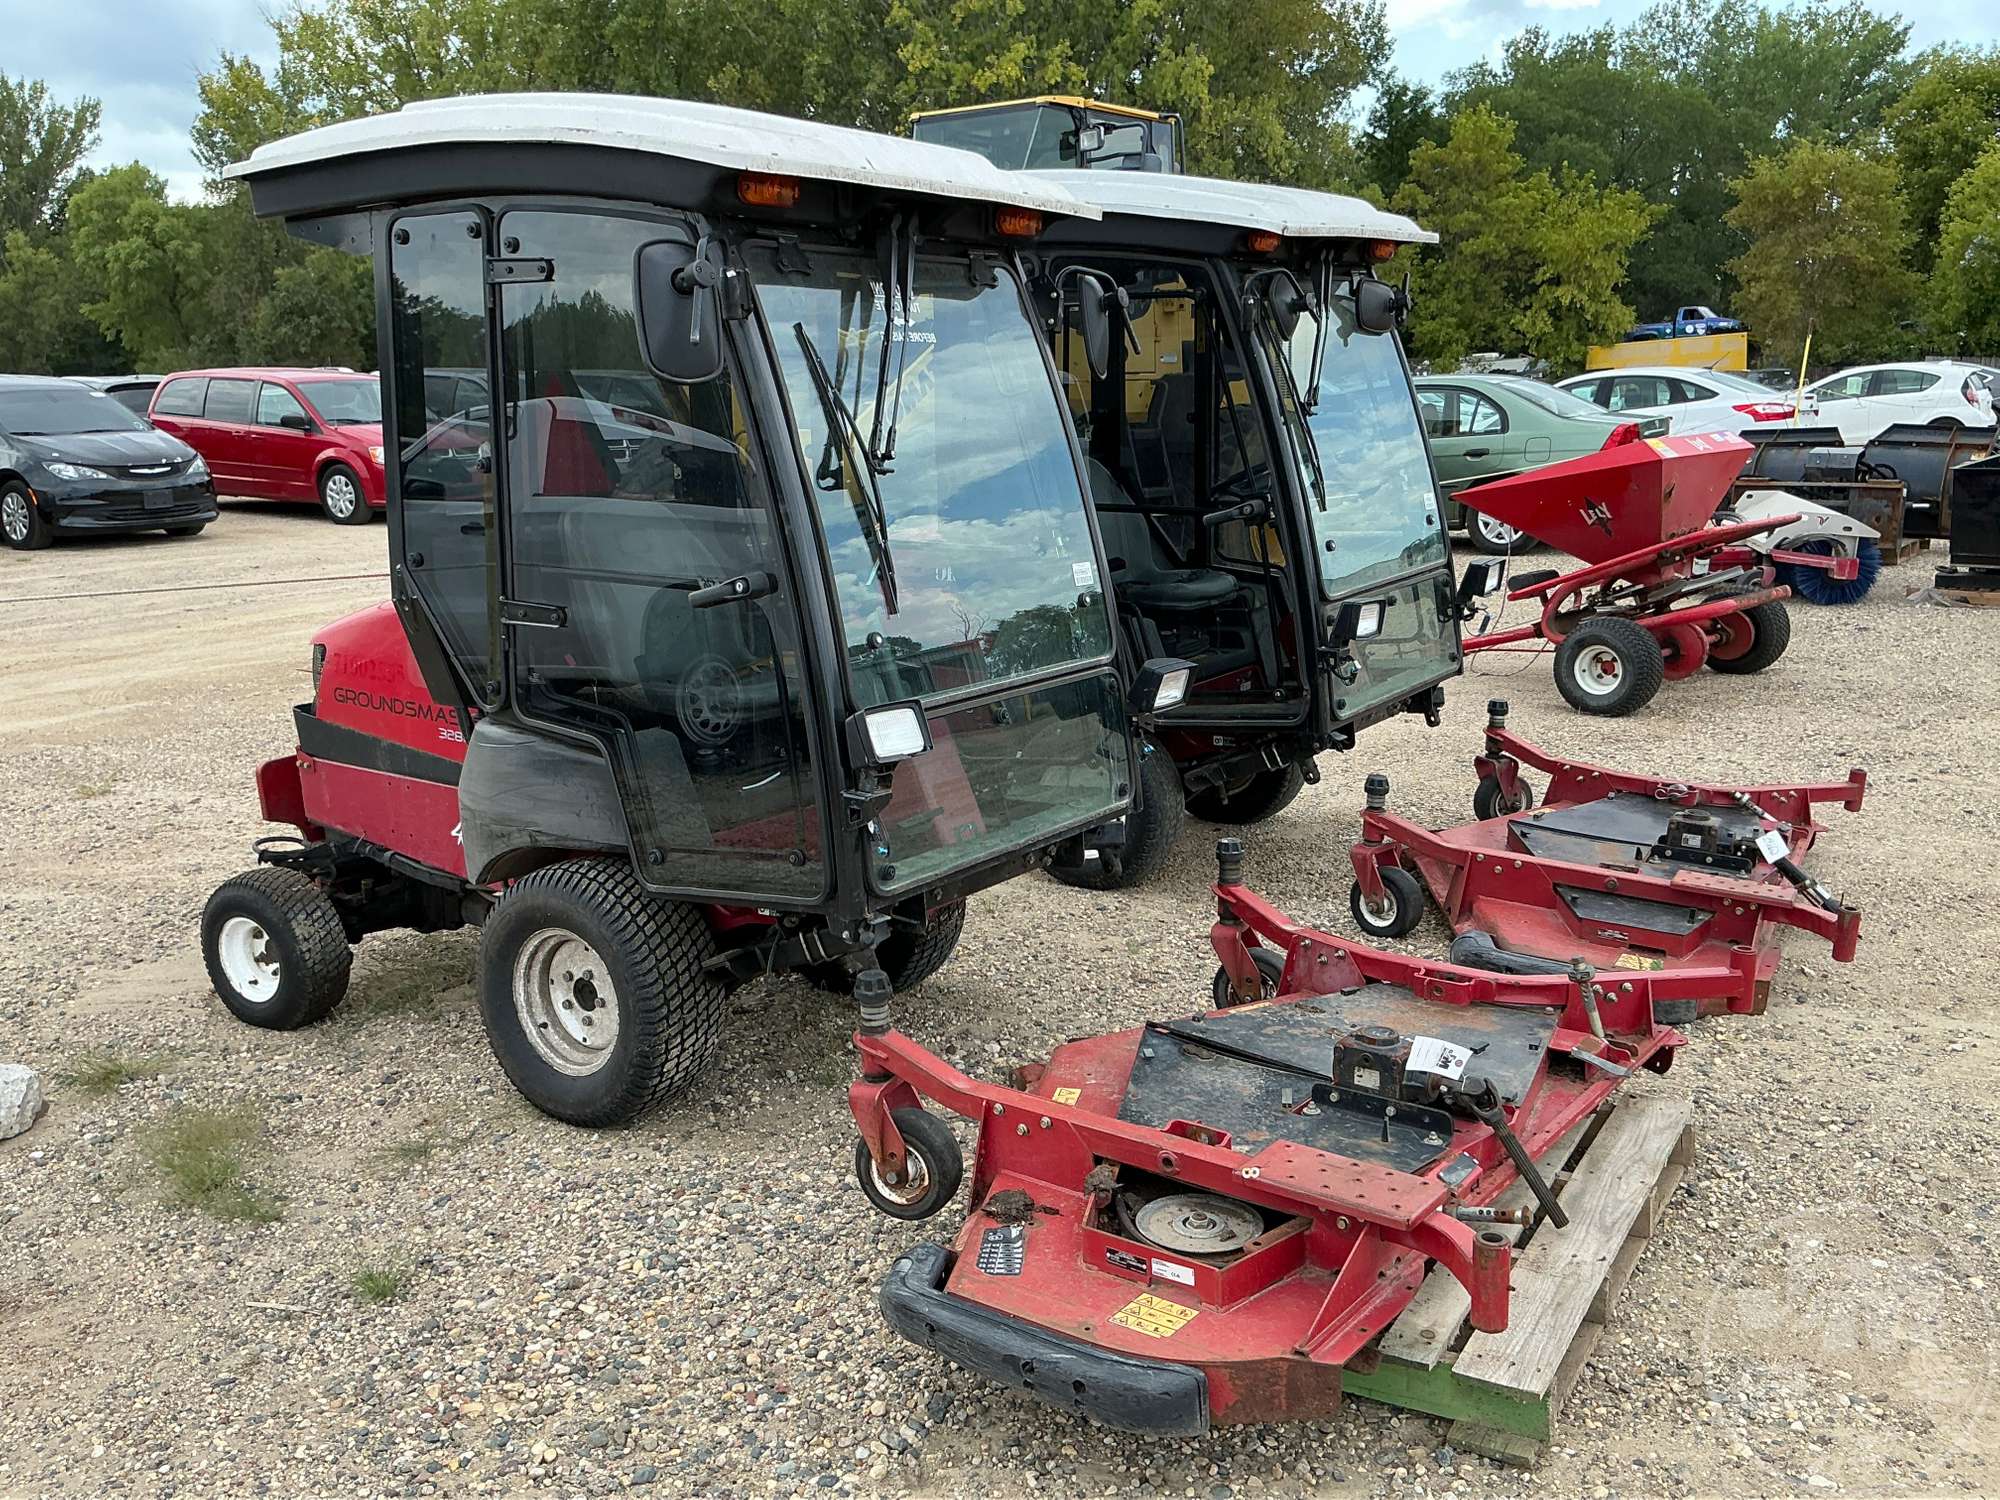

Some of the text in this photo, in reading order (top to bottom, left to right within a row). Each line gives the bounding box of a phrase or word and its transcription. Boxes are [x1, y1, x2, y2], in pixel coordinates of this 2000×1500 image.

[1579, 502, 1613, 526] LELY
[333, 687, 460, 726] GROUNDSMAS
[438, 727, 466, 744] 328
